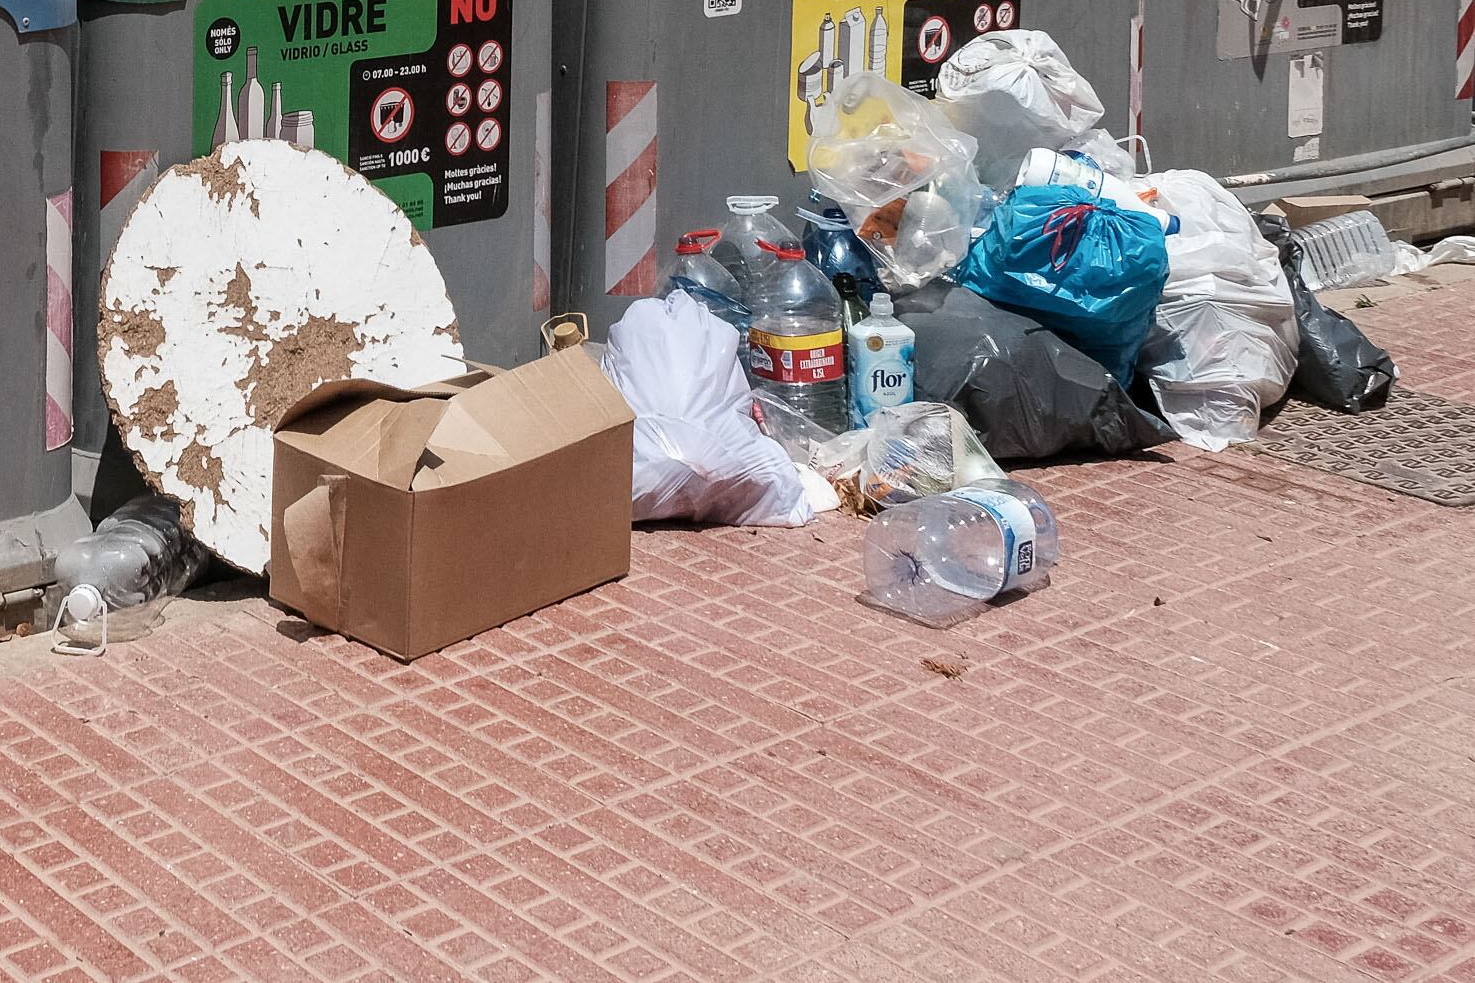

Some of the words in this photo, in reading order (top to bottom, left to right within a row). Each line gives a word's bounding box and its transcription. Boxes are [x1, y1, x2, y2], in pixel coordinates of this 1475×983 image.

[210, 25, 236, 37] NOMÉS
[215, 36, 232, 46] SÓLO
[215, 46, 232, 54] ONLY
[280, 45, 321, 61] VIDRIO
[330, 39, 369, 55] GLASS
[372, 68, 393, 79] 07.00
[400, 65, 420, 76] 23.00
[421, 64, 427, 73] h
[388, 148, 419, 167] 1000
[421, 146, 430, 162] €
[444, 168, 469, 179] Moltes
[469, 162, 497, 175] gràcies!
[444, 179, 474, 194] ¡Muchas
[475, 174, 502, 188] gracias!
[443, 193, 466, 205] Thank
[466, 190, 482, 203] you!
[871, 369, 907, 393] flor
